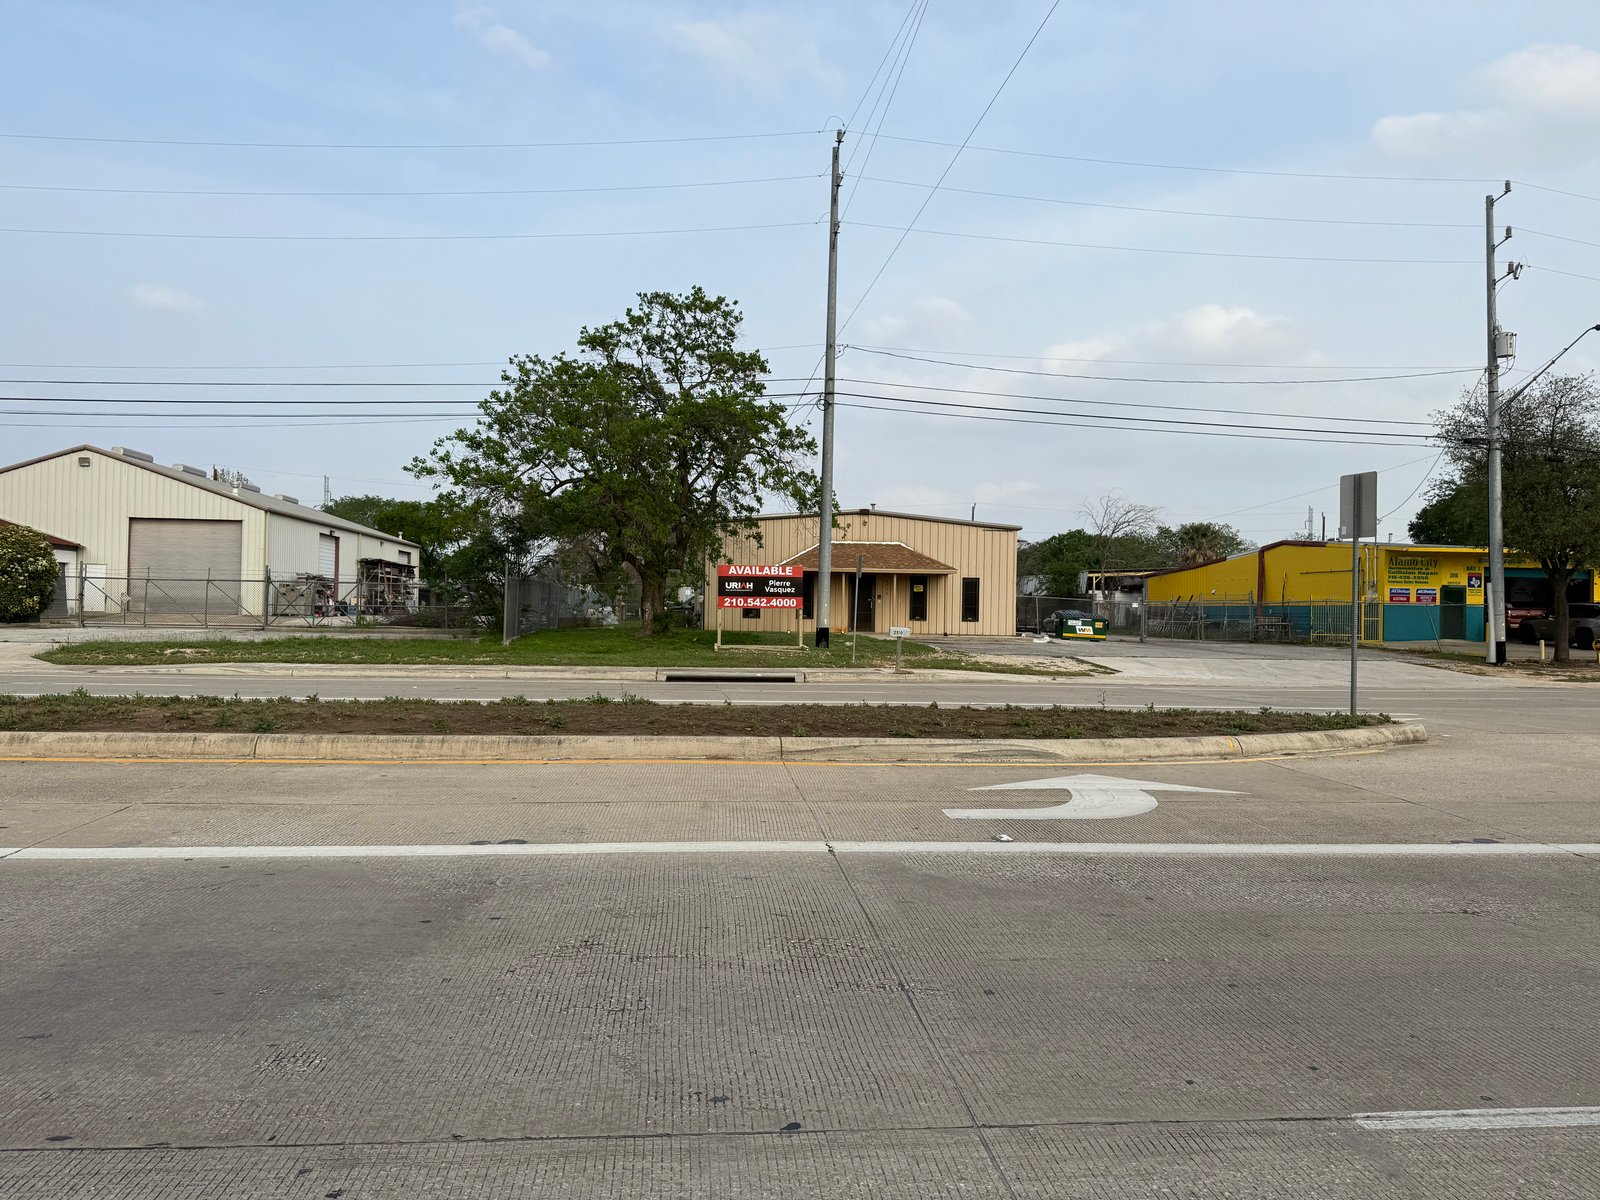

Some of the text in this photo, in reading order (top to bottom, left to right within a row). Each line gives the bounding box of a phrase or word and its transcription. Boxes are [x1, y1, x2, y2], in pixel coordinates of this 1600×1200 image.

[1388, 556, 1438, 568] Alamo City
[728, 566, 793, 575] AVAILABLE
[724, 598, 796, 607] 210.542.4000
